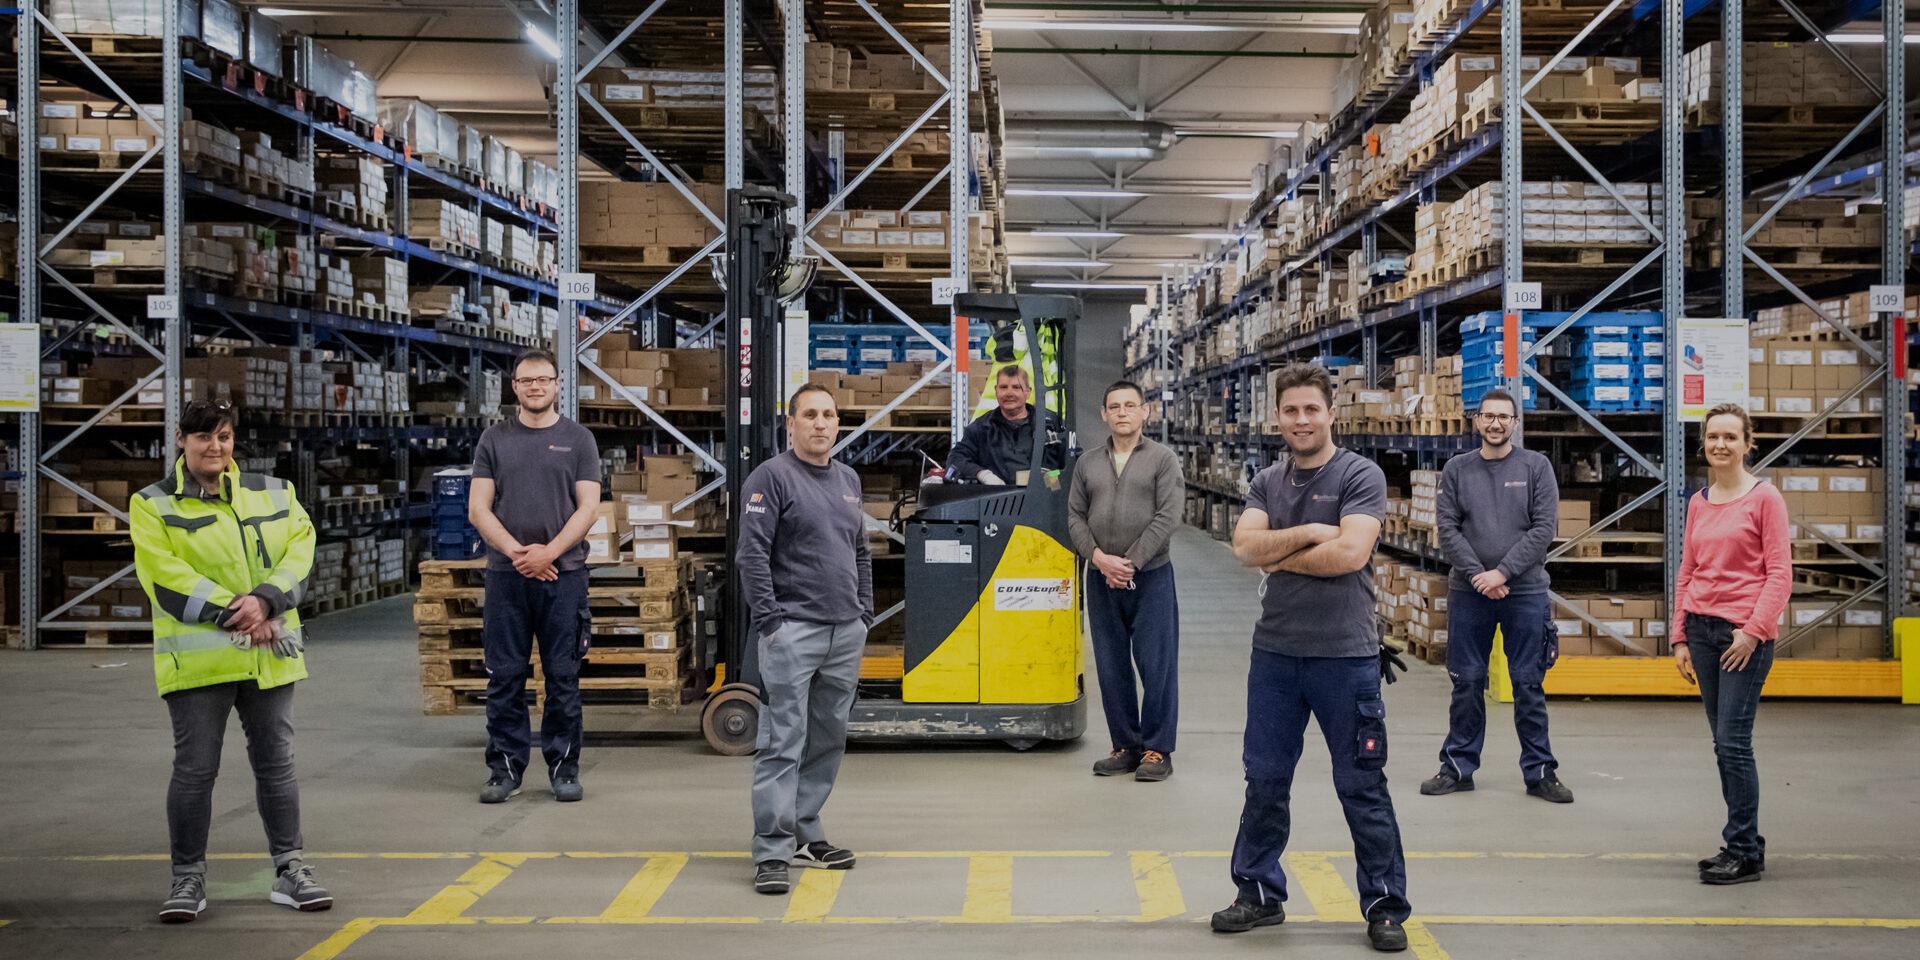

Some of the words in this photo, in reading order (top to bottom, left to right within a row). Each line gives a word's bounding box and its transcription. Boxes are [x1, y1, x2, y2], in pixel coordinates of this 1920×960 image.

[567, 282, 590, 294] 106
[937, 286, 961, 298] 107
[1514, 291, 1537, 303] 108
[1875, 294, 1898, 306] 109
[153, 300, 173, 311] 105
